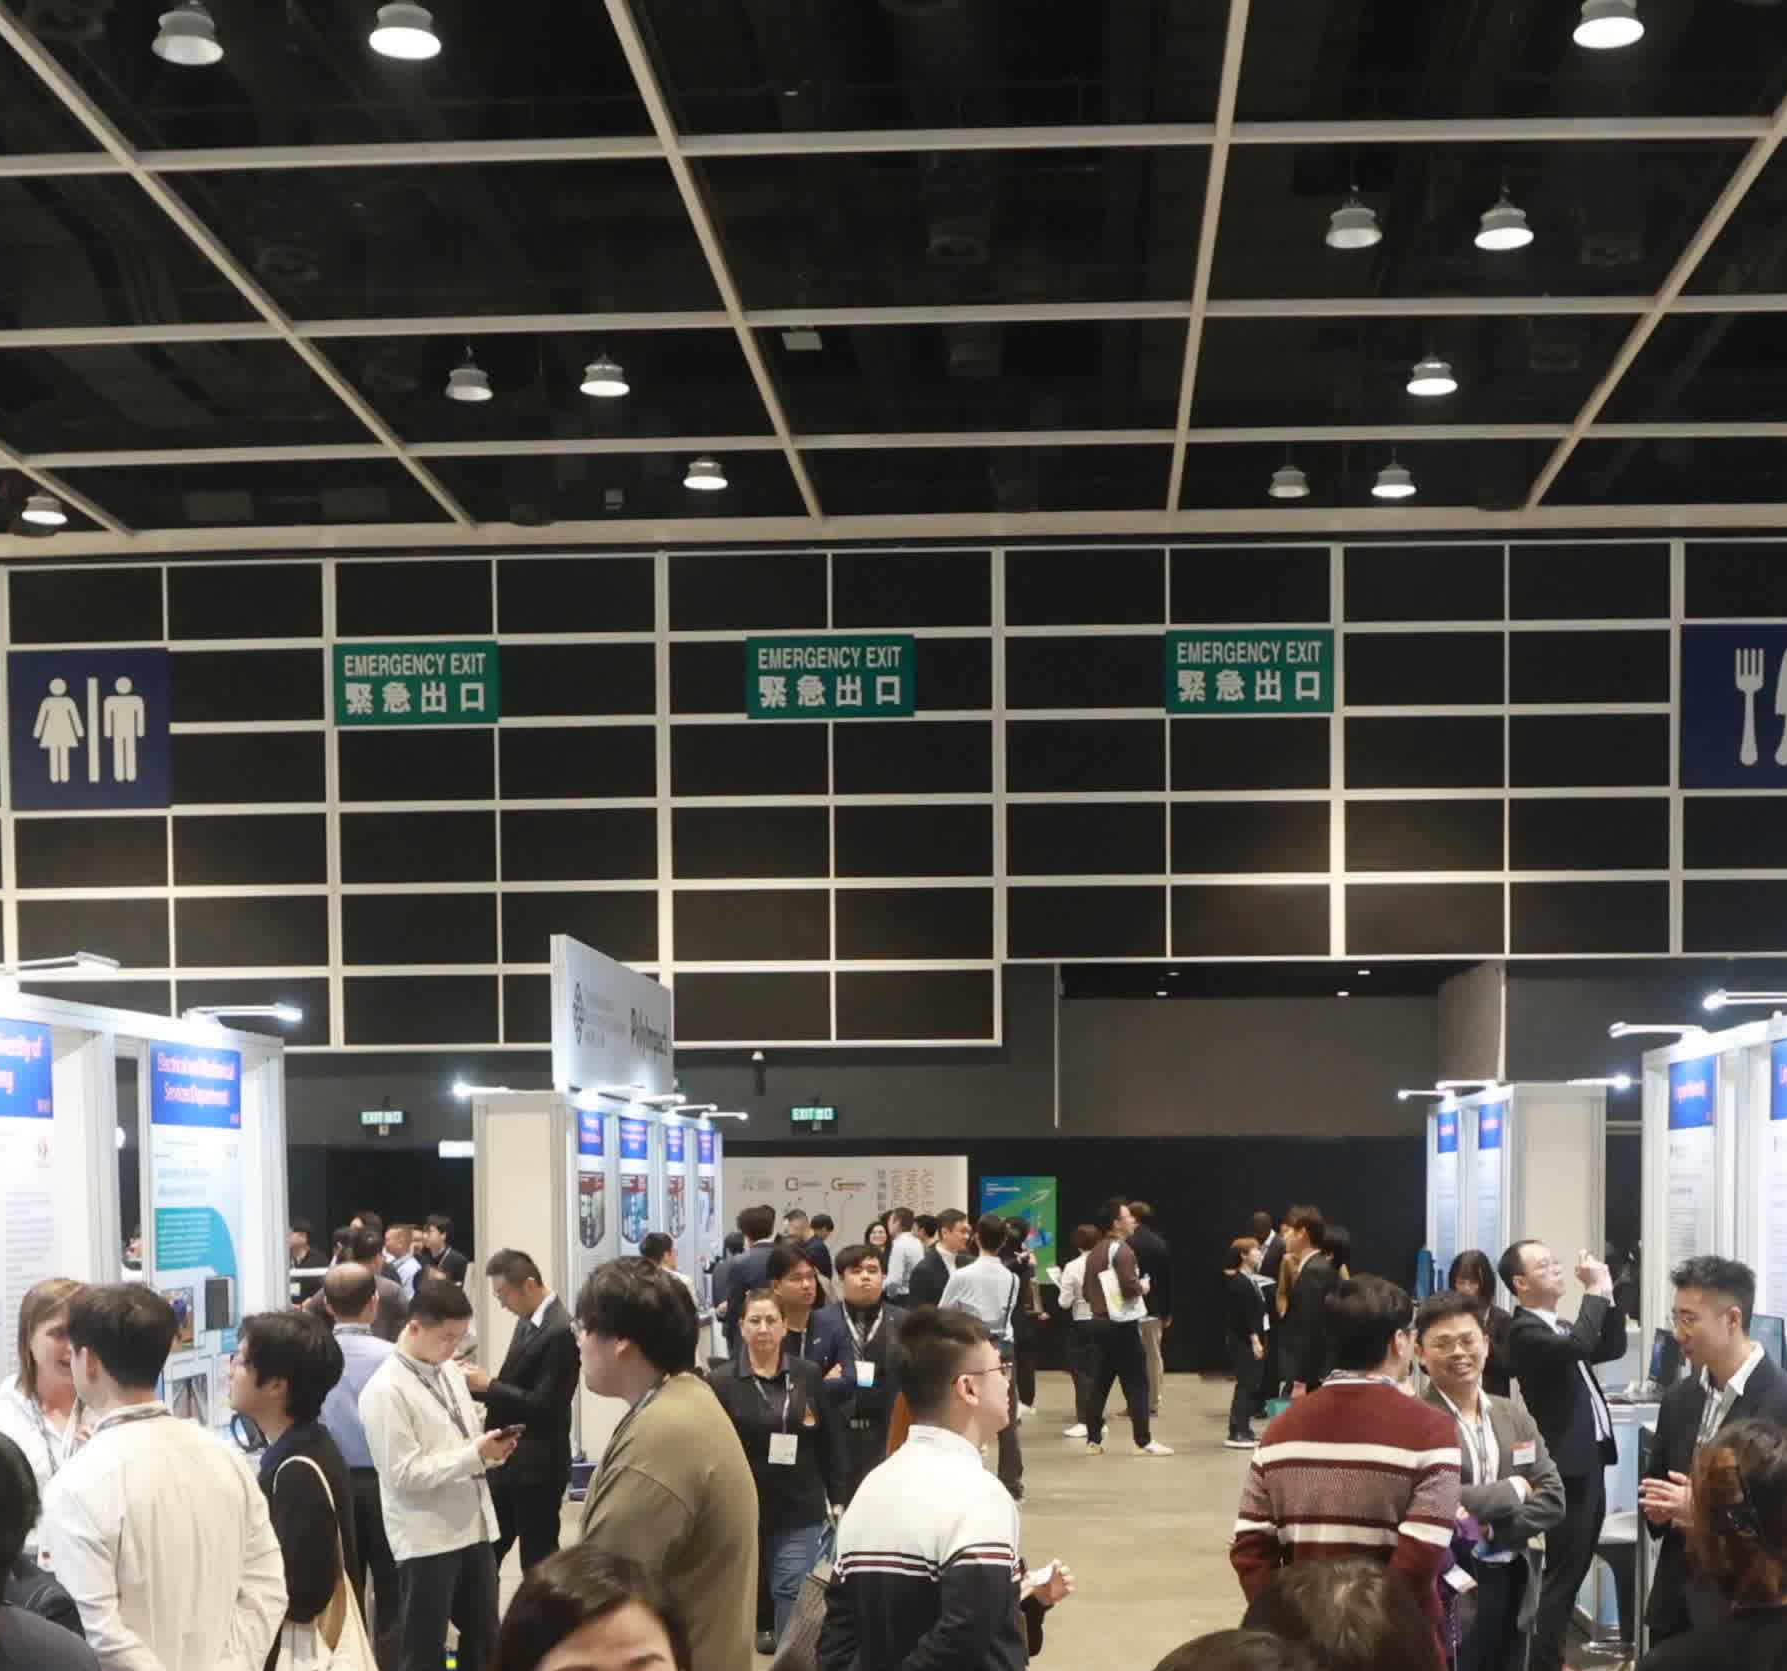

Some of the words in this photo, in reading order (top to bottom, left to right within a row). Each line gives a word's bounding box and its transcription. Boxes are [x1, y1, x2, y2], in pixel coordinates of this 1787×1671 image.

[344, 653, 444, 676] EMERGENCY
[450, 652, 486, 676] EXIT
[758, 646, 861, 670] EMERGENCY
[866, 645, 902, 669] EXIT
[1177, 641, 1281, 664] EMERGENCY
[1286, 640, 1322, 664] EXIT
[344, 681, 486, 715] 緊急出口
[758, 675, 902, 708] 緊急出口
[1177, 669, 1321, 702] 緊急出口
